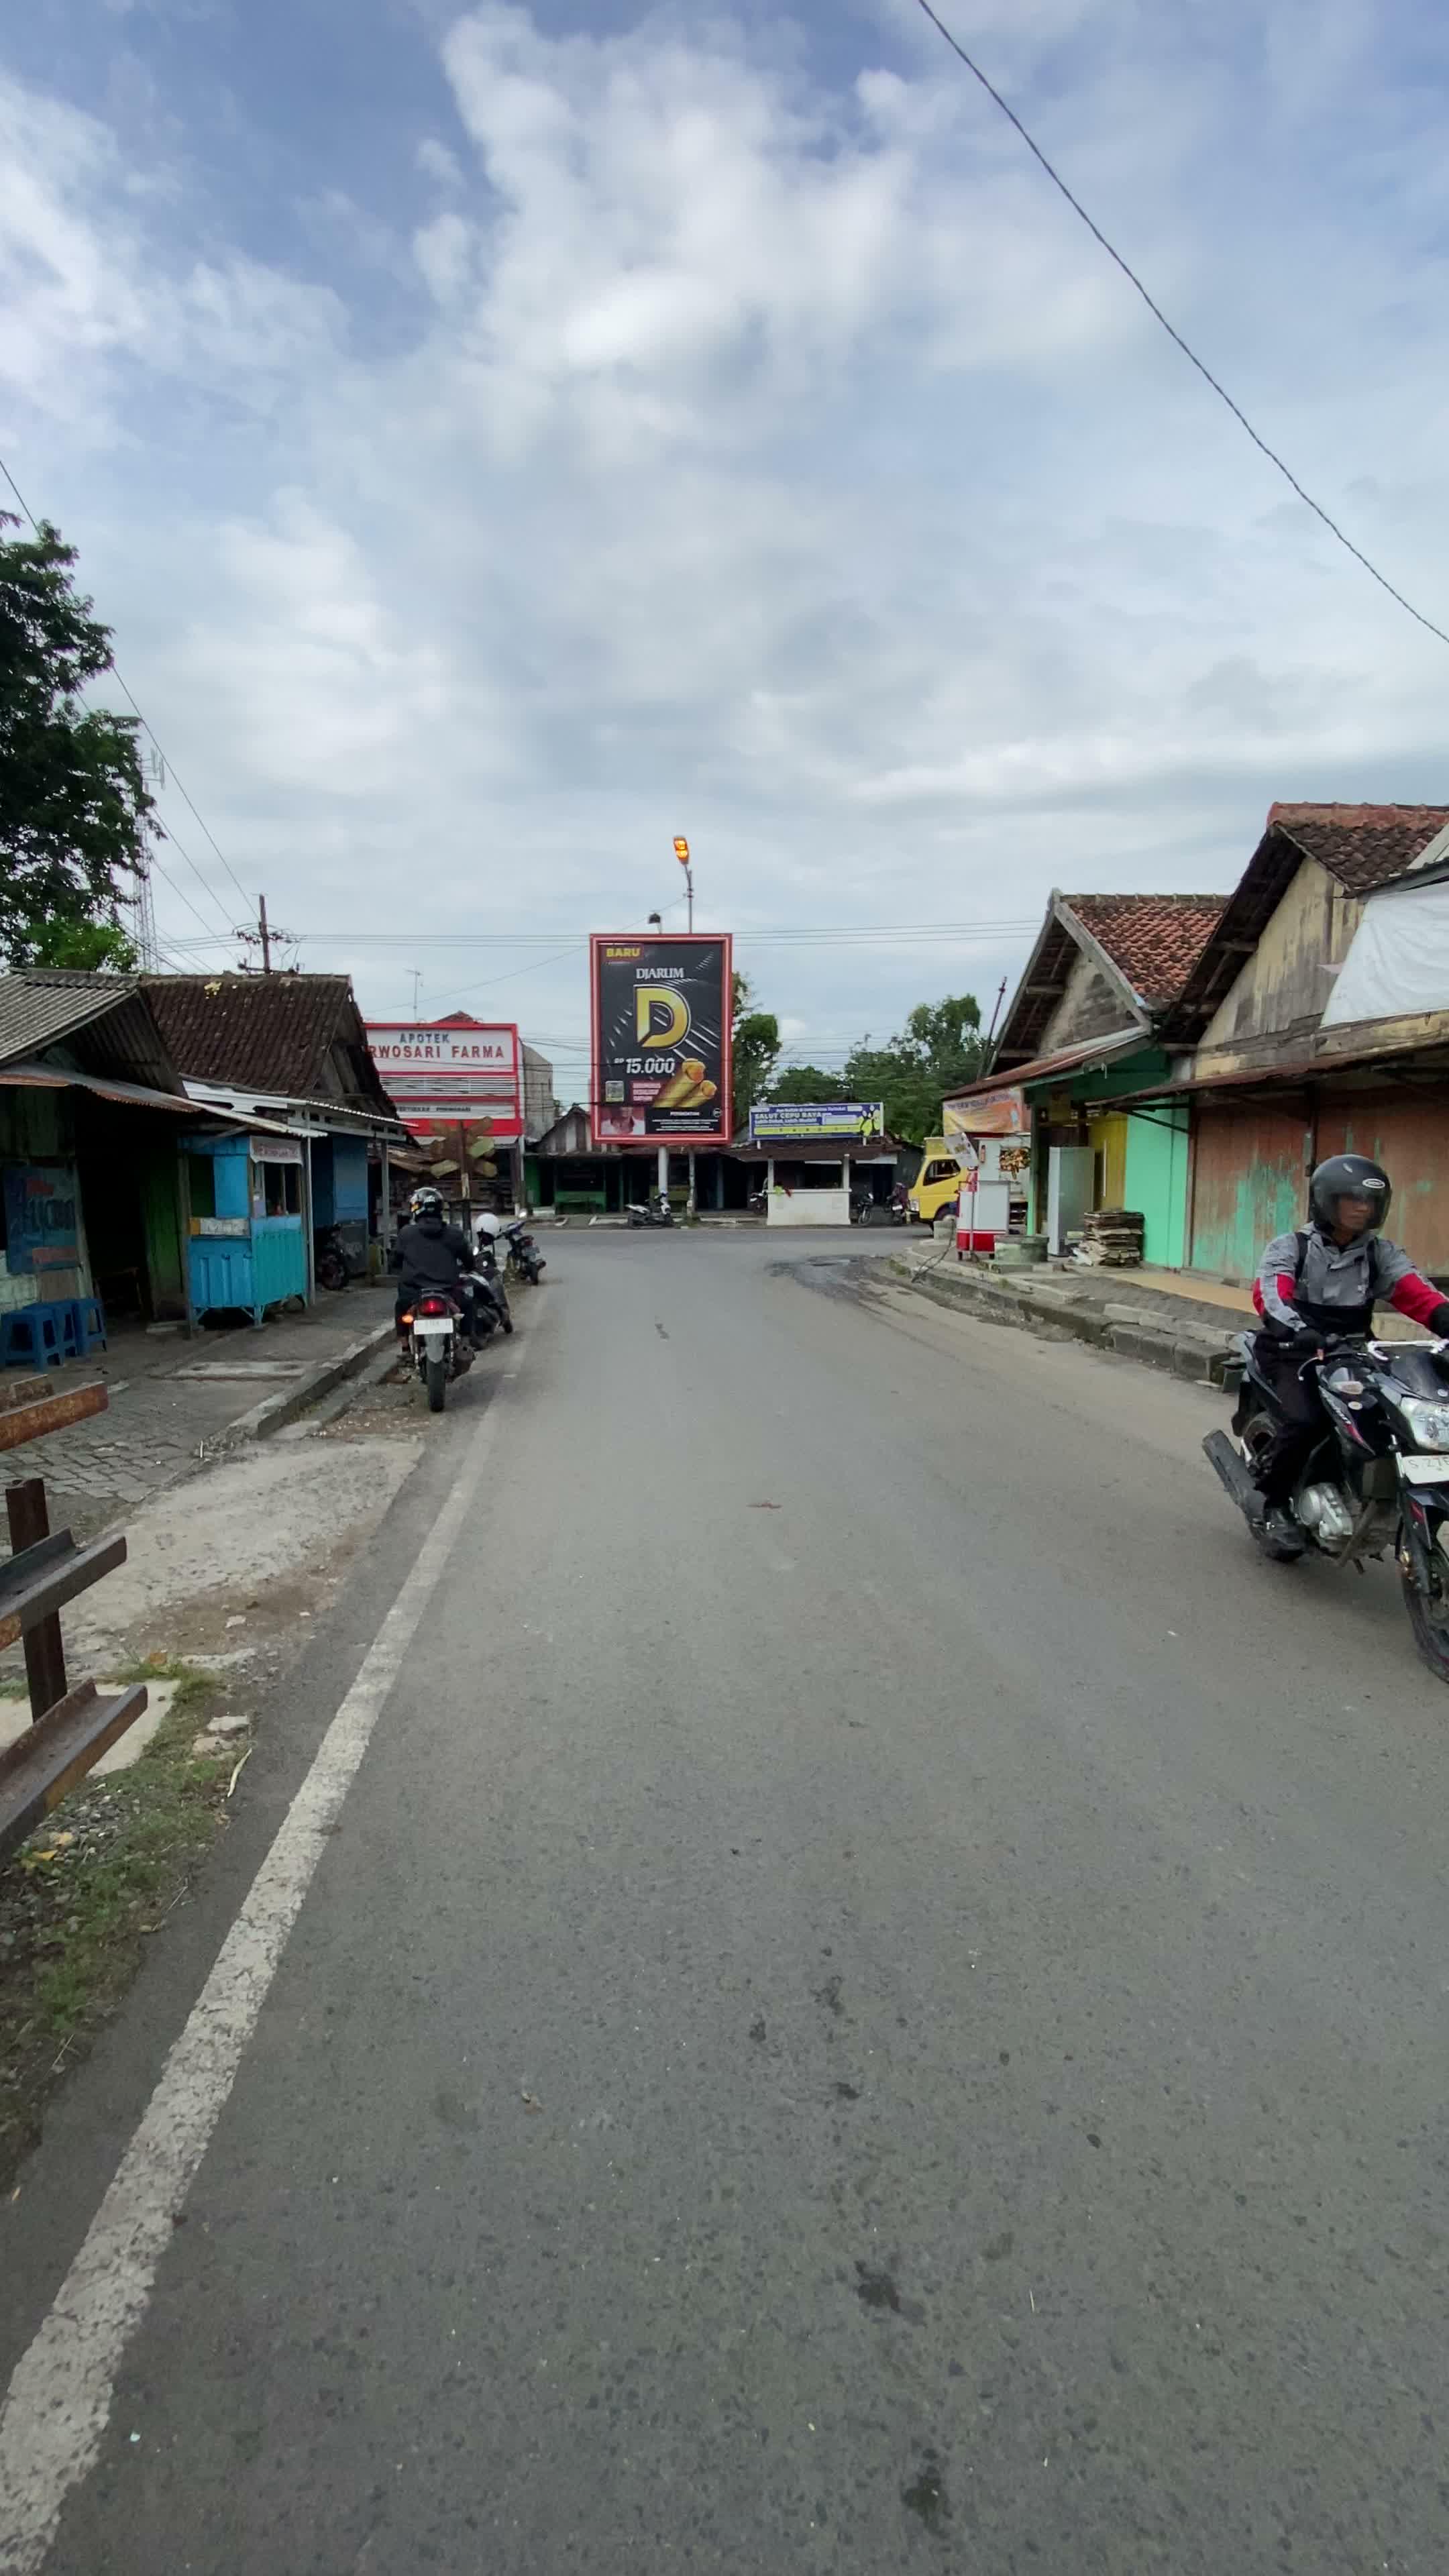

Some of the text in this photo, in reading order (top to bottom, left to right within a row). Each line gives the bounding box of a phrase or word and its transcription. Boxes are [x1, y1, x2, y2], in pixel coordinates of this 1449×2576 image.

[606, 947, 641, 957] BARU
[635, 967, 684, 979] DJARUM
[633, 983, 692, 1051] D
[400, 1033, 449, 1042] APOTEK
[451, 1045, 504, 1058] FARMA
[626, 1057, 675, 1073] 15.000
